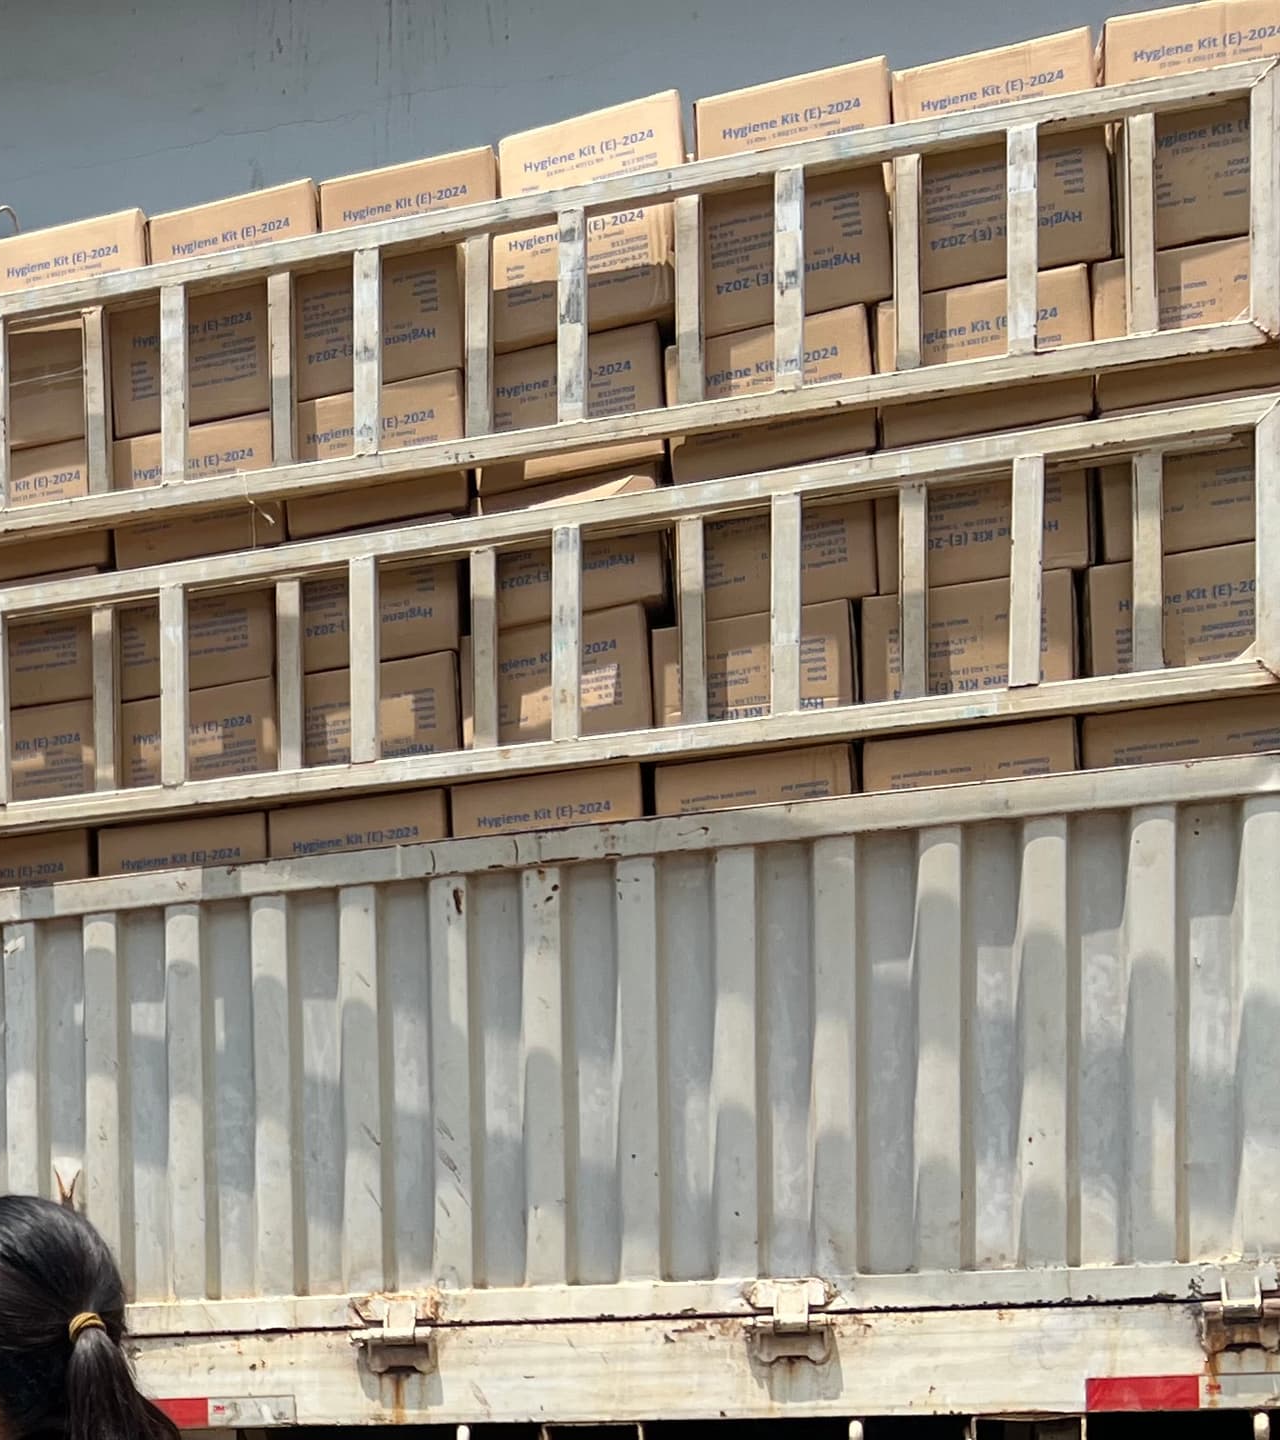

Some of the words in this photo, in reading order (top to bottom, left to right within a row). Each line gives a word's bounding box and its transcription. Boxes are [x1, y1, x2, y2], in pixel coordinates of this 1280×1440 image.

[1133, 42, 1194, 63] Hygiene
[1198, 32, 1220, 49] Kit
[921, 90, 978, 112] Hygiene
[982, 80, 1002, 97] Kit
[1005, 69, 1065, 93] (E)-2024
[722, 118, 777, 141] Hygiene
[781, 109, 801, 125] Kit
[804, 97, 861, 122] (E)-2024
[523, 152, 576, 174] Hygiene
[578, 143, 597, 158] Kit
[600, 129, 654, 154] (E)-2024
[343, 202, 392, 222] Hygiene
[395, 195, 413, 210] Kit
[415, 184, 468, 208] (E)-2024
[589, 209, 645, 232] (E)-2024
[1039, 210, 1083, 228] Hygie
[172, 235, 218, 256] Hygiene
[221, 228, 237, 242] Kit
[240, 217, 290, 240] (E)-2024
[6, 260, 50, 279] Hygiene
[53, 254, 69, 267] Kit
[72, 244, 119, 266] (E)-2024
[971, 318, 991, 334] Kit
[308, 346, 354, 365] E)-2024
[755, 359, 775, 375] Kit
[496, 379, 549, 400] Hygiene
[589, 360, 632, 378] )-2024
[15, 476, 30, 491] Kit
[32, 469, 81, 490] (E)-2024
[501, 571, 552, 591] E)-2024
[1211, 579, 1255, 599] (E)-20
[305, 621, 346, 638] )-2024
[477, 812, 530, 829] Hygiene
[534, 808, 552, 821] Kit
[556, 801, 611, 820] (E)-2024
[293, 837, 343, 854] Hygiene
[346, 832, 363, 846] Kit
[0, 865, 16, 879] Kit
[121, 854, 168, 871] Hygiene
[171, 851, 187, 865] Kit
